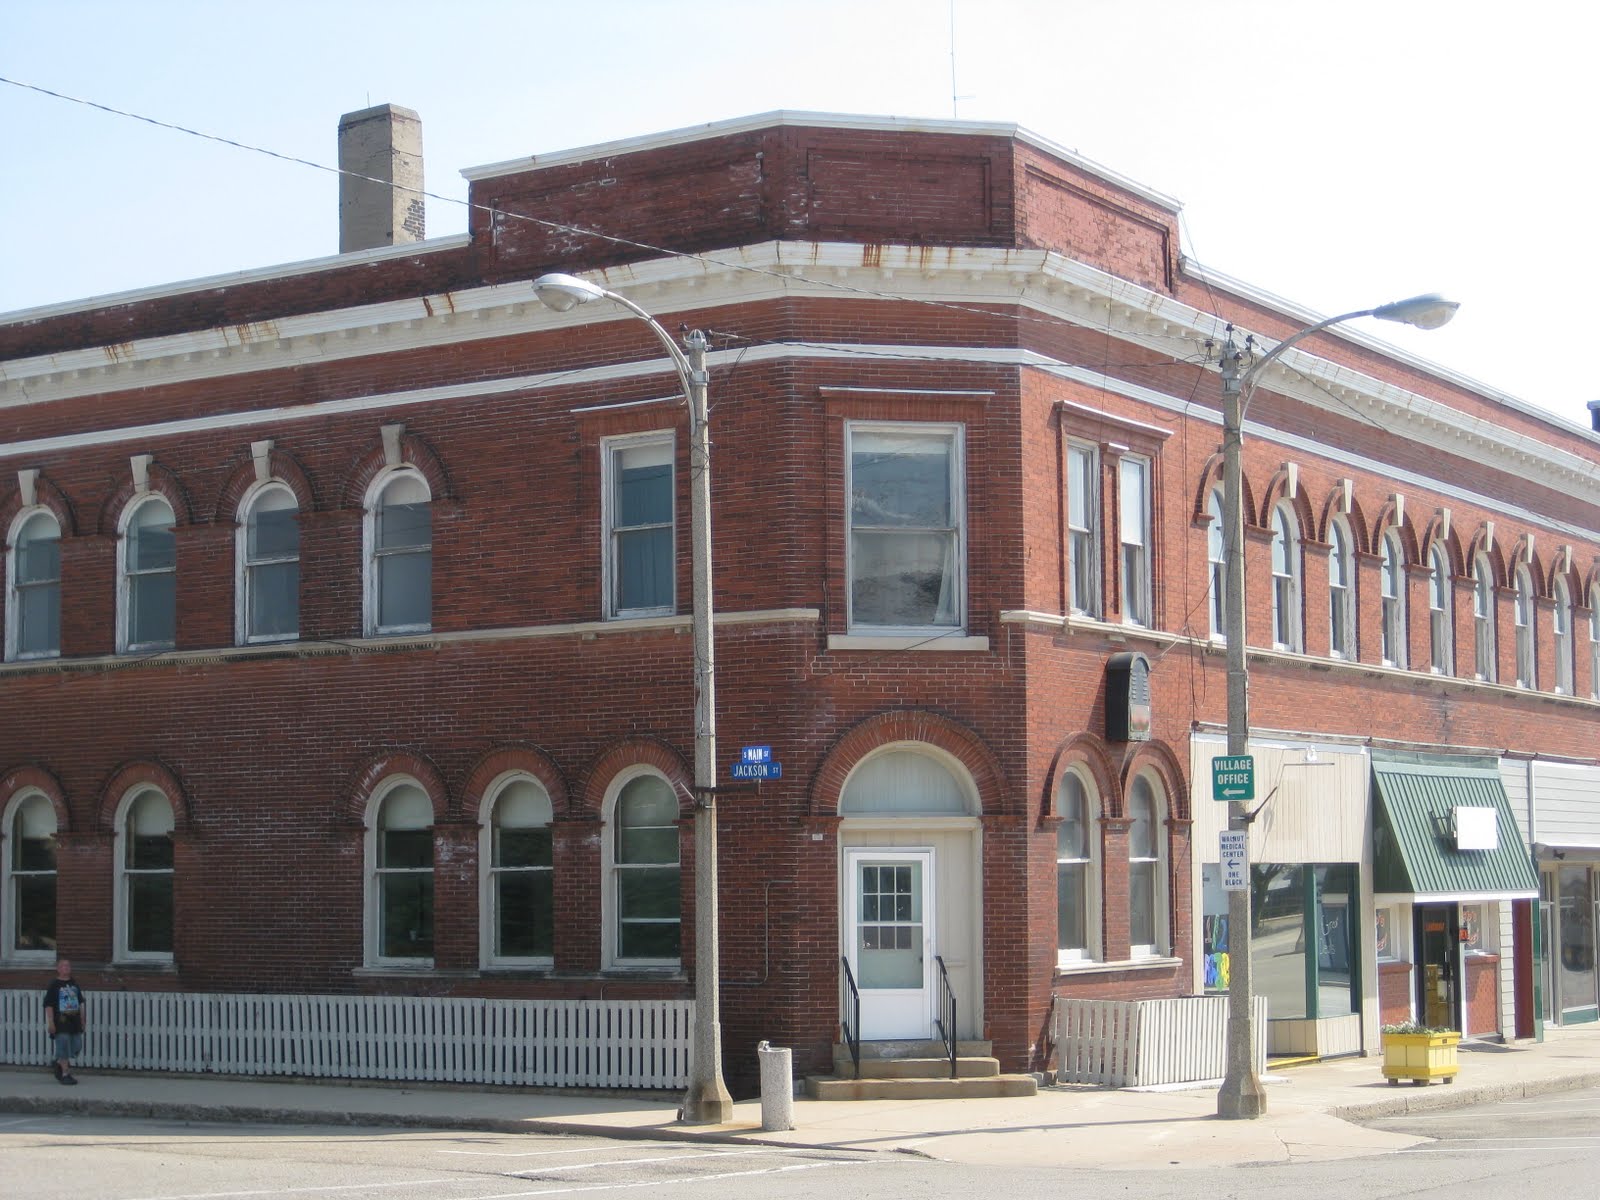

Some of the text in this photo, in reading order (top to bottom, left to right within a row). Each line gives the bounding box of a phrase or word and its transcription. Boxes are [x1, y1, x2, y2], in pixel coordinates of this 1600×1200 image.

[748, 749, 762, 760] MAIN
[734, 765, 768, 776] JACKSON
[1214, 759, 1252, 771] VILLAGE
[1217, 773, 1249, 785] OFFICE
[1221, 835, 1244, 843] WALNUT
[1222, 850, 1244, 858] CENTER
